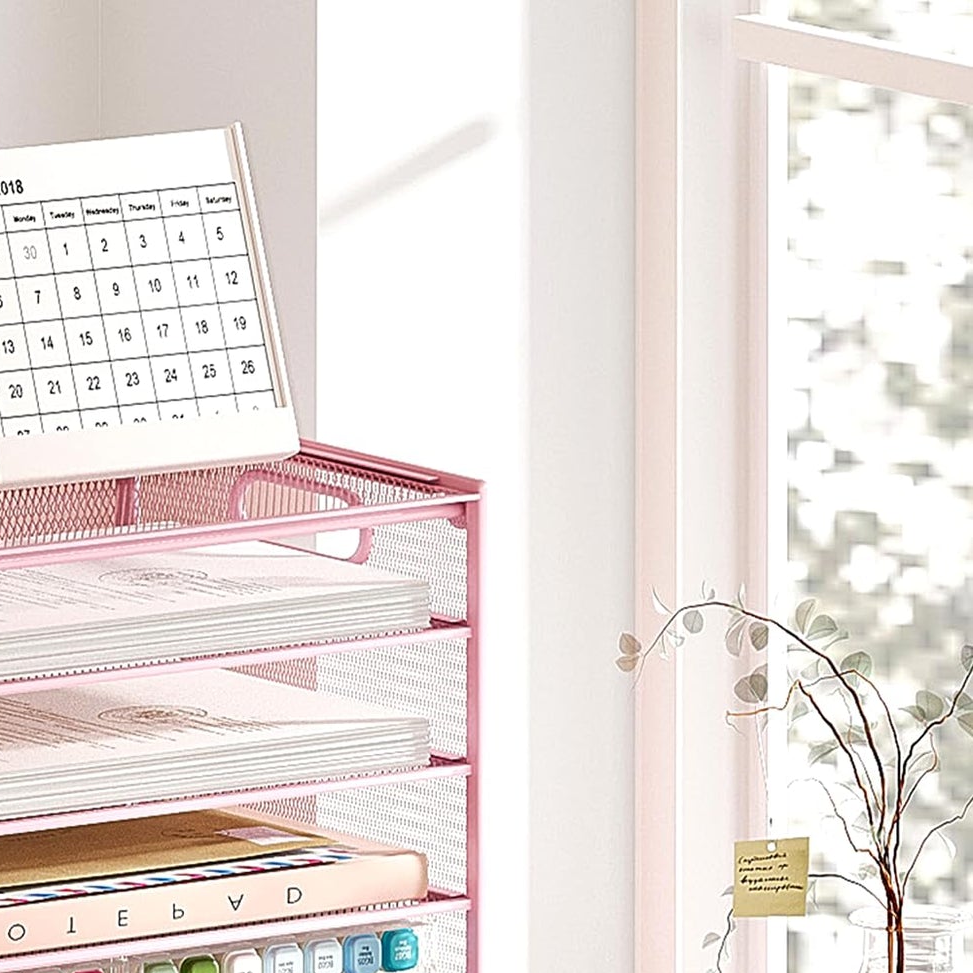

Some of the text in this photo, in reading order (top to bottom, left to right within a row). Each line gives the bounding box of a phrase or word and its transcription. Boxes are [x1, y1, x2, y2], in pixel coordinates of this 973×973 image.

[22, 244, 38, 261] 30
[63, 242, 69, 256] 1
[100, 237, 109, 253] 2
[139, 234, 148, 249] 3
[178, 231, 185, 243] 4
[216, 226, 225, 241] 5
[34, 289, 41, 305] 7
[73, 286, 82, 301] 8
[112, 282, 121, 297] 9
[148, 277, 162, 293] 10
[186, 274, 200, 289] 11
[225, 270, 239, 285] 12
[1, 315, 247, 354] 13 14 15 16 17 18 19
[8, 359, 256, 399] 20 21 22 23 24 25 26
